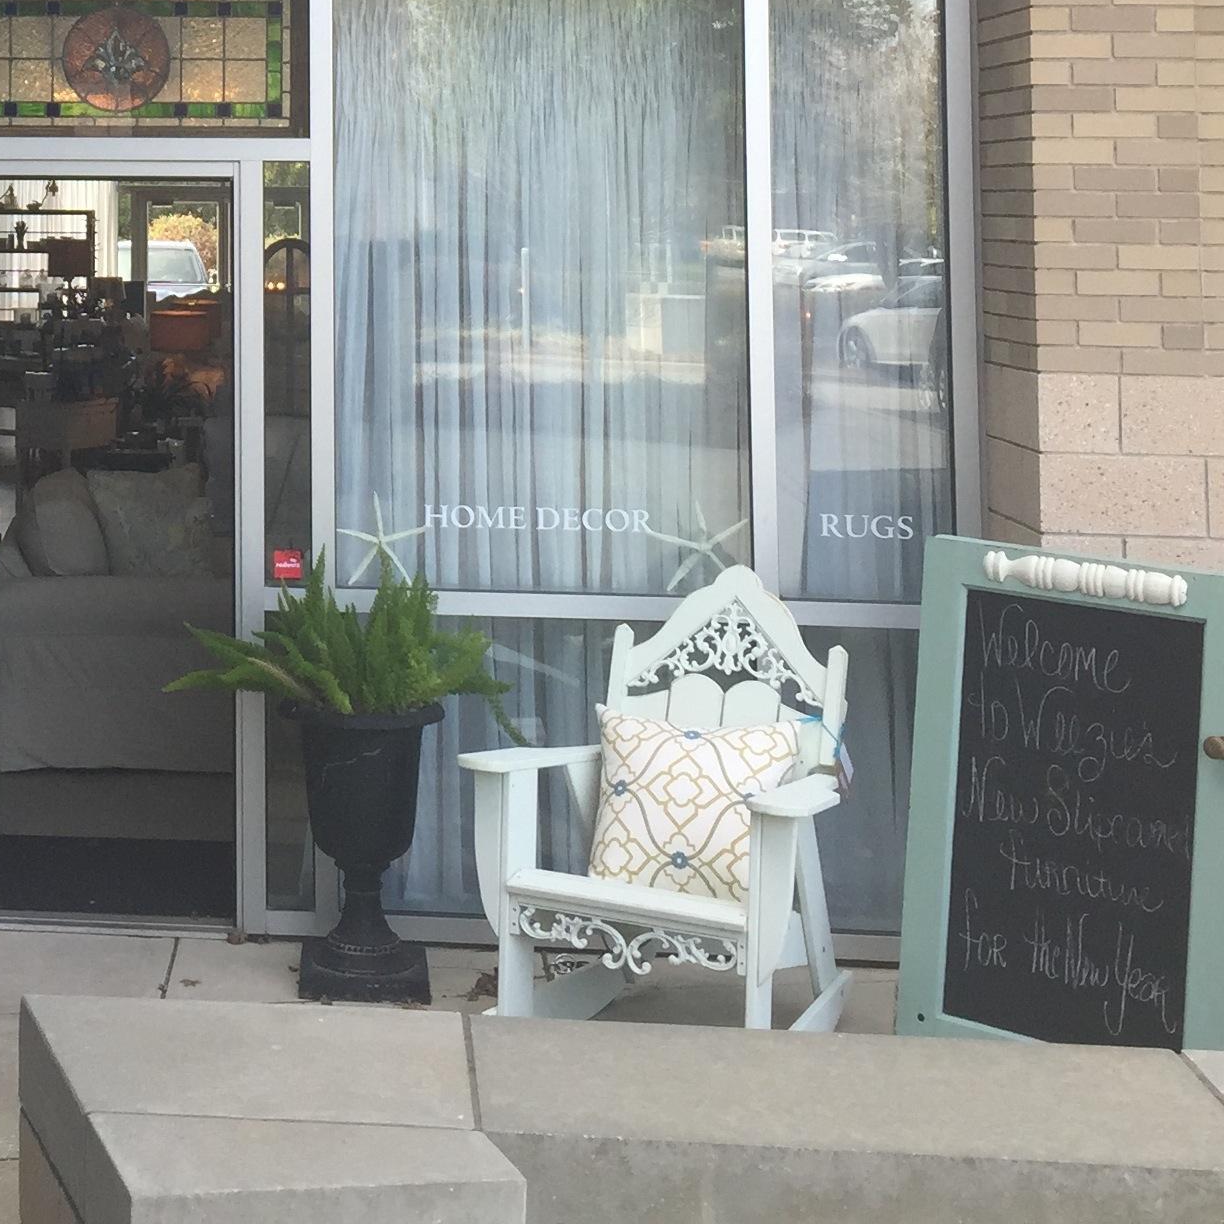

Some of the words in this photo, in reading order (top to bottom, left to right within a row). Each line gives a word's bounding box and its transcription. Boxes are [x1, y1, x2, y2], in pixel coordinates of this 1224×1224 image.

[424, 504, 526, 531] HOME
[534, 507, 652, 534] DECOR
[819, 512, 914, 540] RUGS
